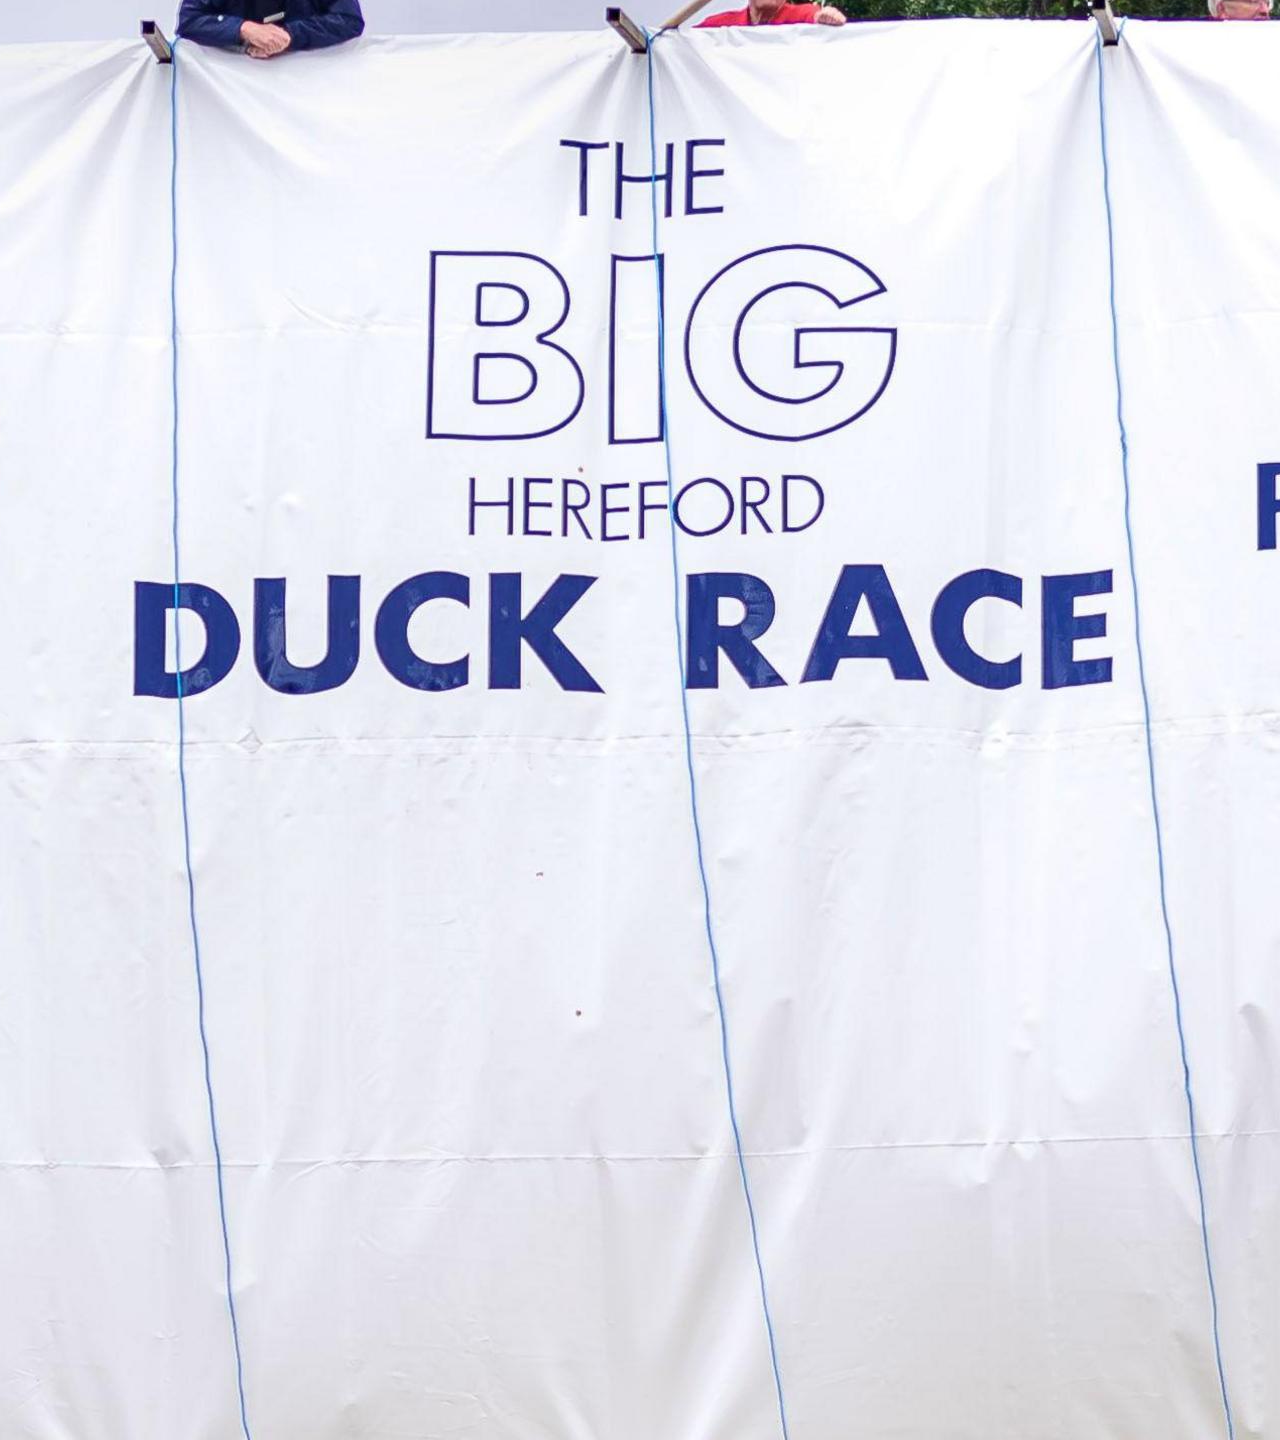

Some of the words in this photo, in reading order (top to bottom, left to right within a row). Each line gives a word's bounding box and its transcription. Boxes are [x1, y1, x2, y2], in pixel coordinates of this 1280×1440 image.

[560, 137, 726, 220] THE
[424, 242, 898, 445] BIG
[467, 475, 826, 542] HEREFORD
[132, 570, 605, 697] DUCK
[683, 563, 1115, 691] RACE
